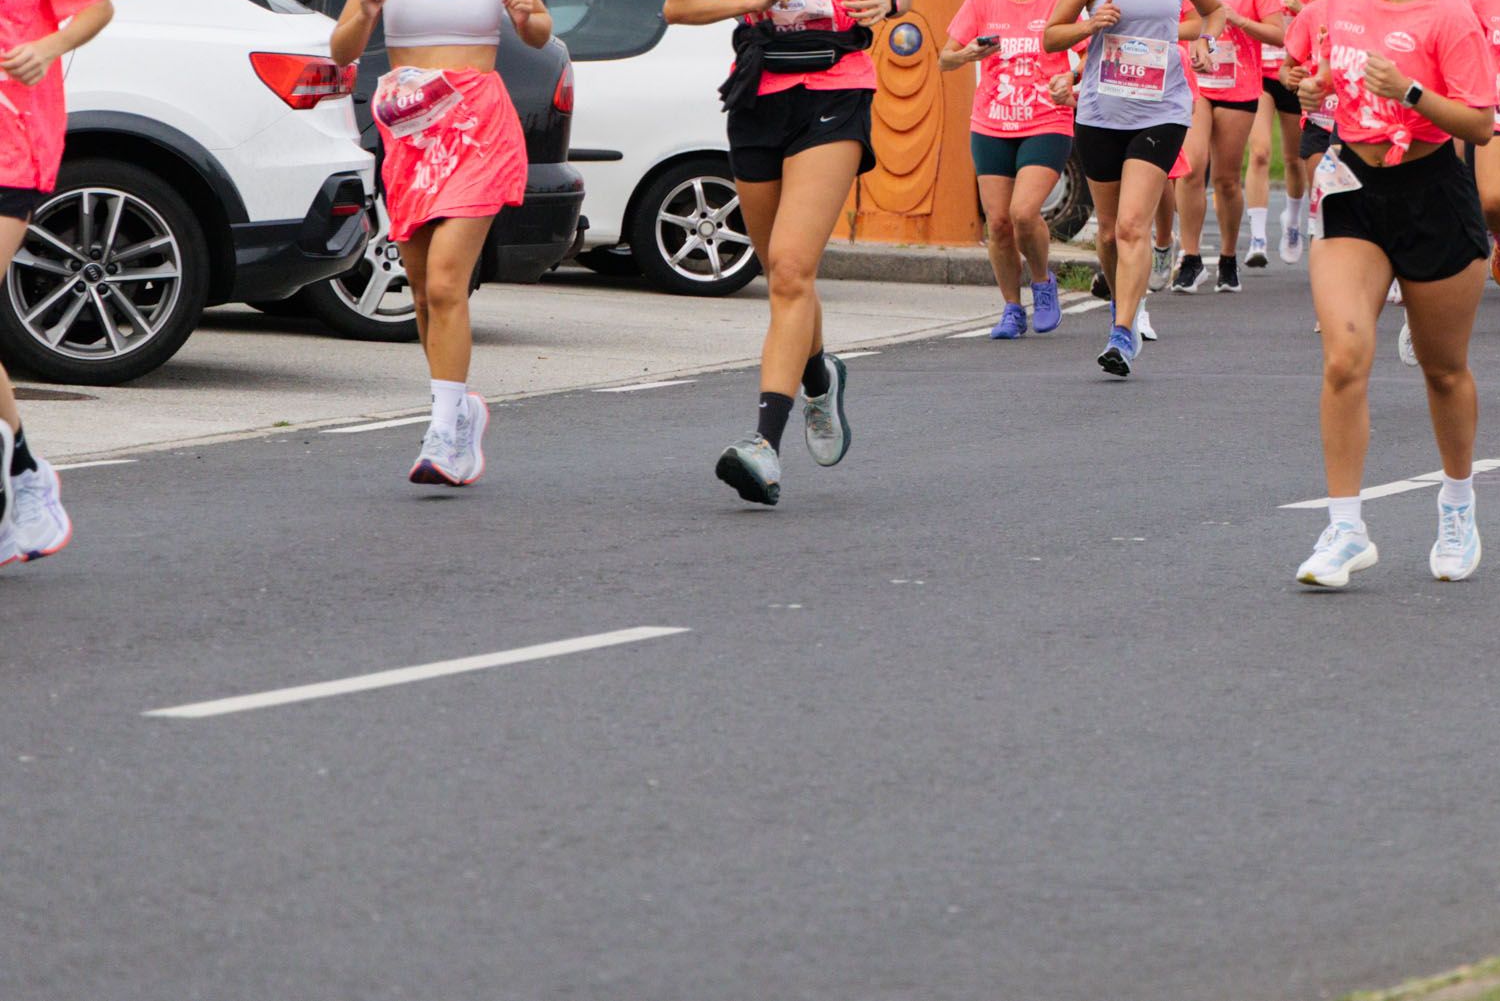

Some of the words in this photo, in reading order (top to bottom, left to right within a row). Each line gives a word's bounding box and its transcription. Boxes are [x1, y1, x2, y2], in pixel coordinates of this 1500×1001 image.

[1001, 37, 1041, 53] RRERA
[1120, 64, 1146, 77] 016
[397, 88, 425, 109] 016
[988, 104, 1033, 121] MUJER
